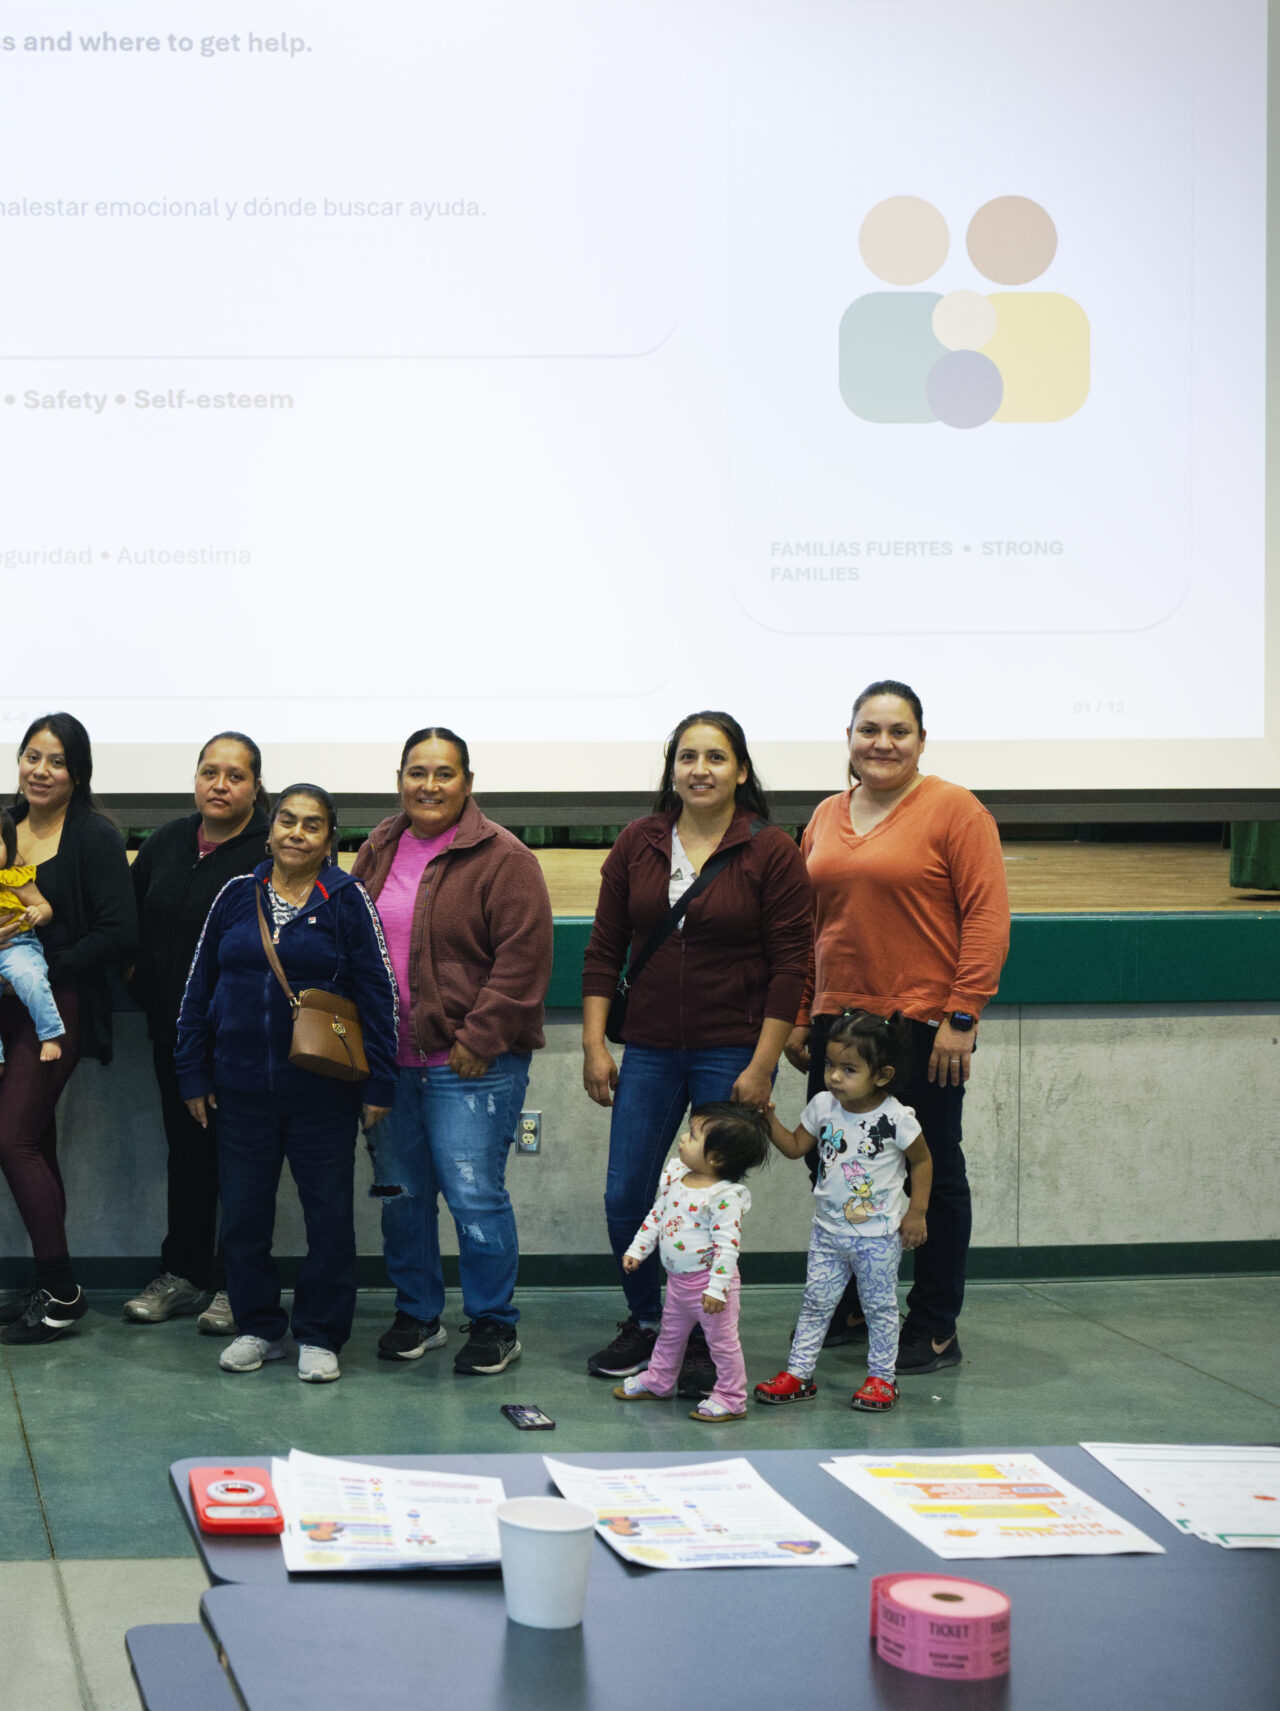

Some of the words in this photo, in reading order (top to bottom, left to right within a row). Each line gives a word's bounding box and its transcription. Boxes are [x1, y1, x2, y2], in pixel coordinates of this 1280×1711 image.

[23, 30, 74, 53] and
[79, 31, 162, 54] where
[167, 34, 195, 54] to
[200, 34, 242, 58] get
[248, 33, 314, 59] help.
[95, 197, 221, 219] emocional
[224, 203, 238, 222] y
[243, 196, 319, 218] dónde
[324, 197, 405, 218] buscar
[409, 198, 488, 222] ayuda.
[23, 389, 110, 416] Safety
[134, 388, 296, 411] Self-esteem
[117, 546, 253, 567] Autoestima
[770, 540, 862, 558] FAMILIAS
[866, 540, 955, 558] FUERTES
[982, 539, 1065, 558] STRONG
[770, 566, 862, 584] FAMILIES
[1073, 702, 1092, 716] 01
[1107, 701, 1127, 716] 12
[928, 1622, 969, 1639] TICKET
